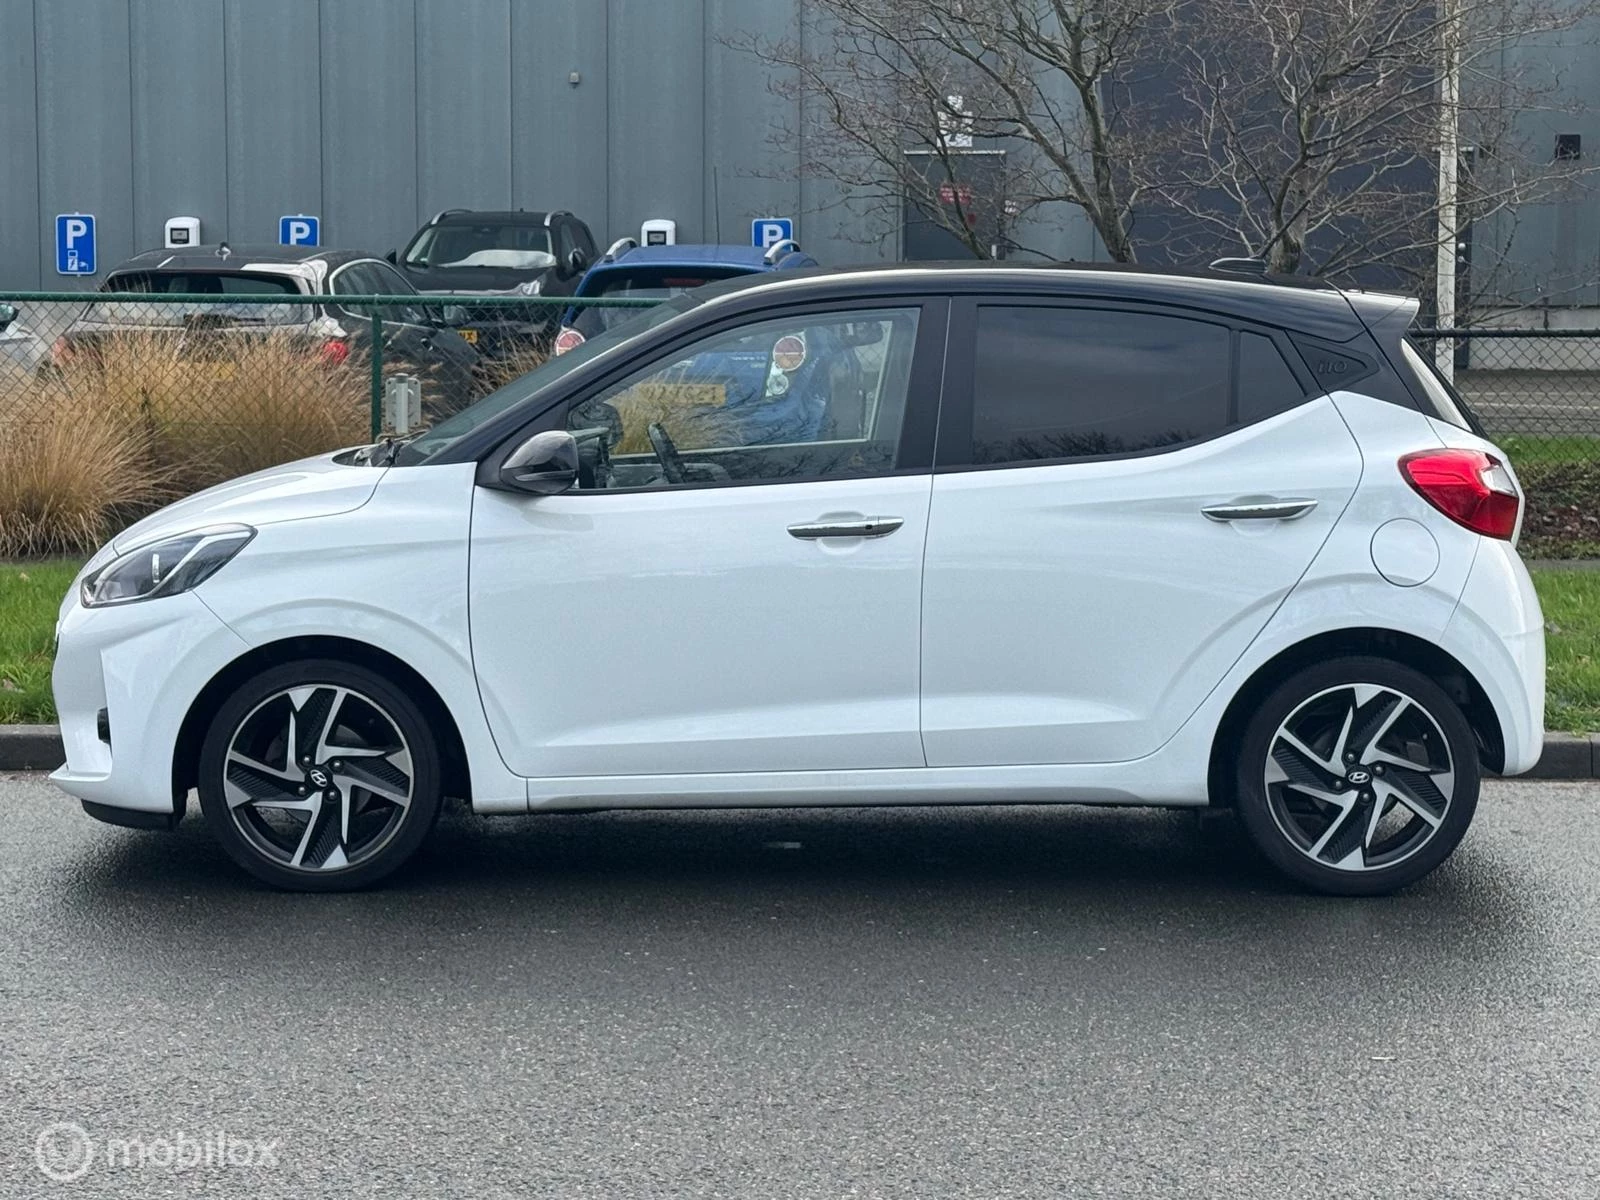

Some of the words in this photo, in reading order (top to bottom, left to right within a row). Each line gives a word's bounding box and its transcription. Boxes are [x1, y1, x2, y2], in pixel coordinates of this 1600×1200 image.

[66, 219, 87, 249] P
[290, 221, 310, 245] P
[762, 224, 784, 248] P
